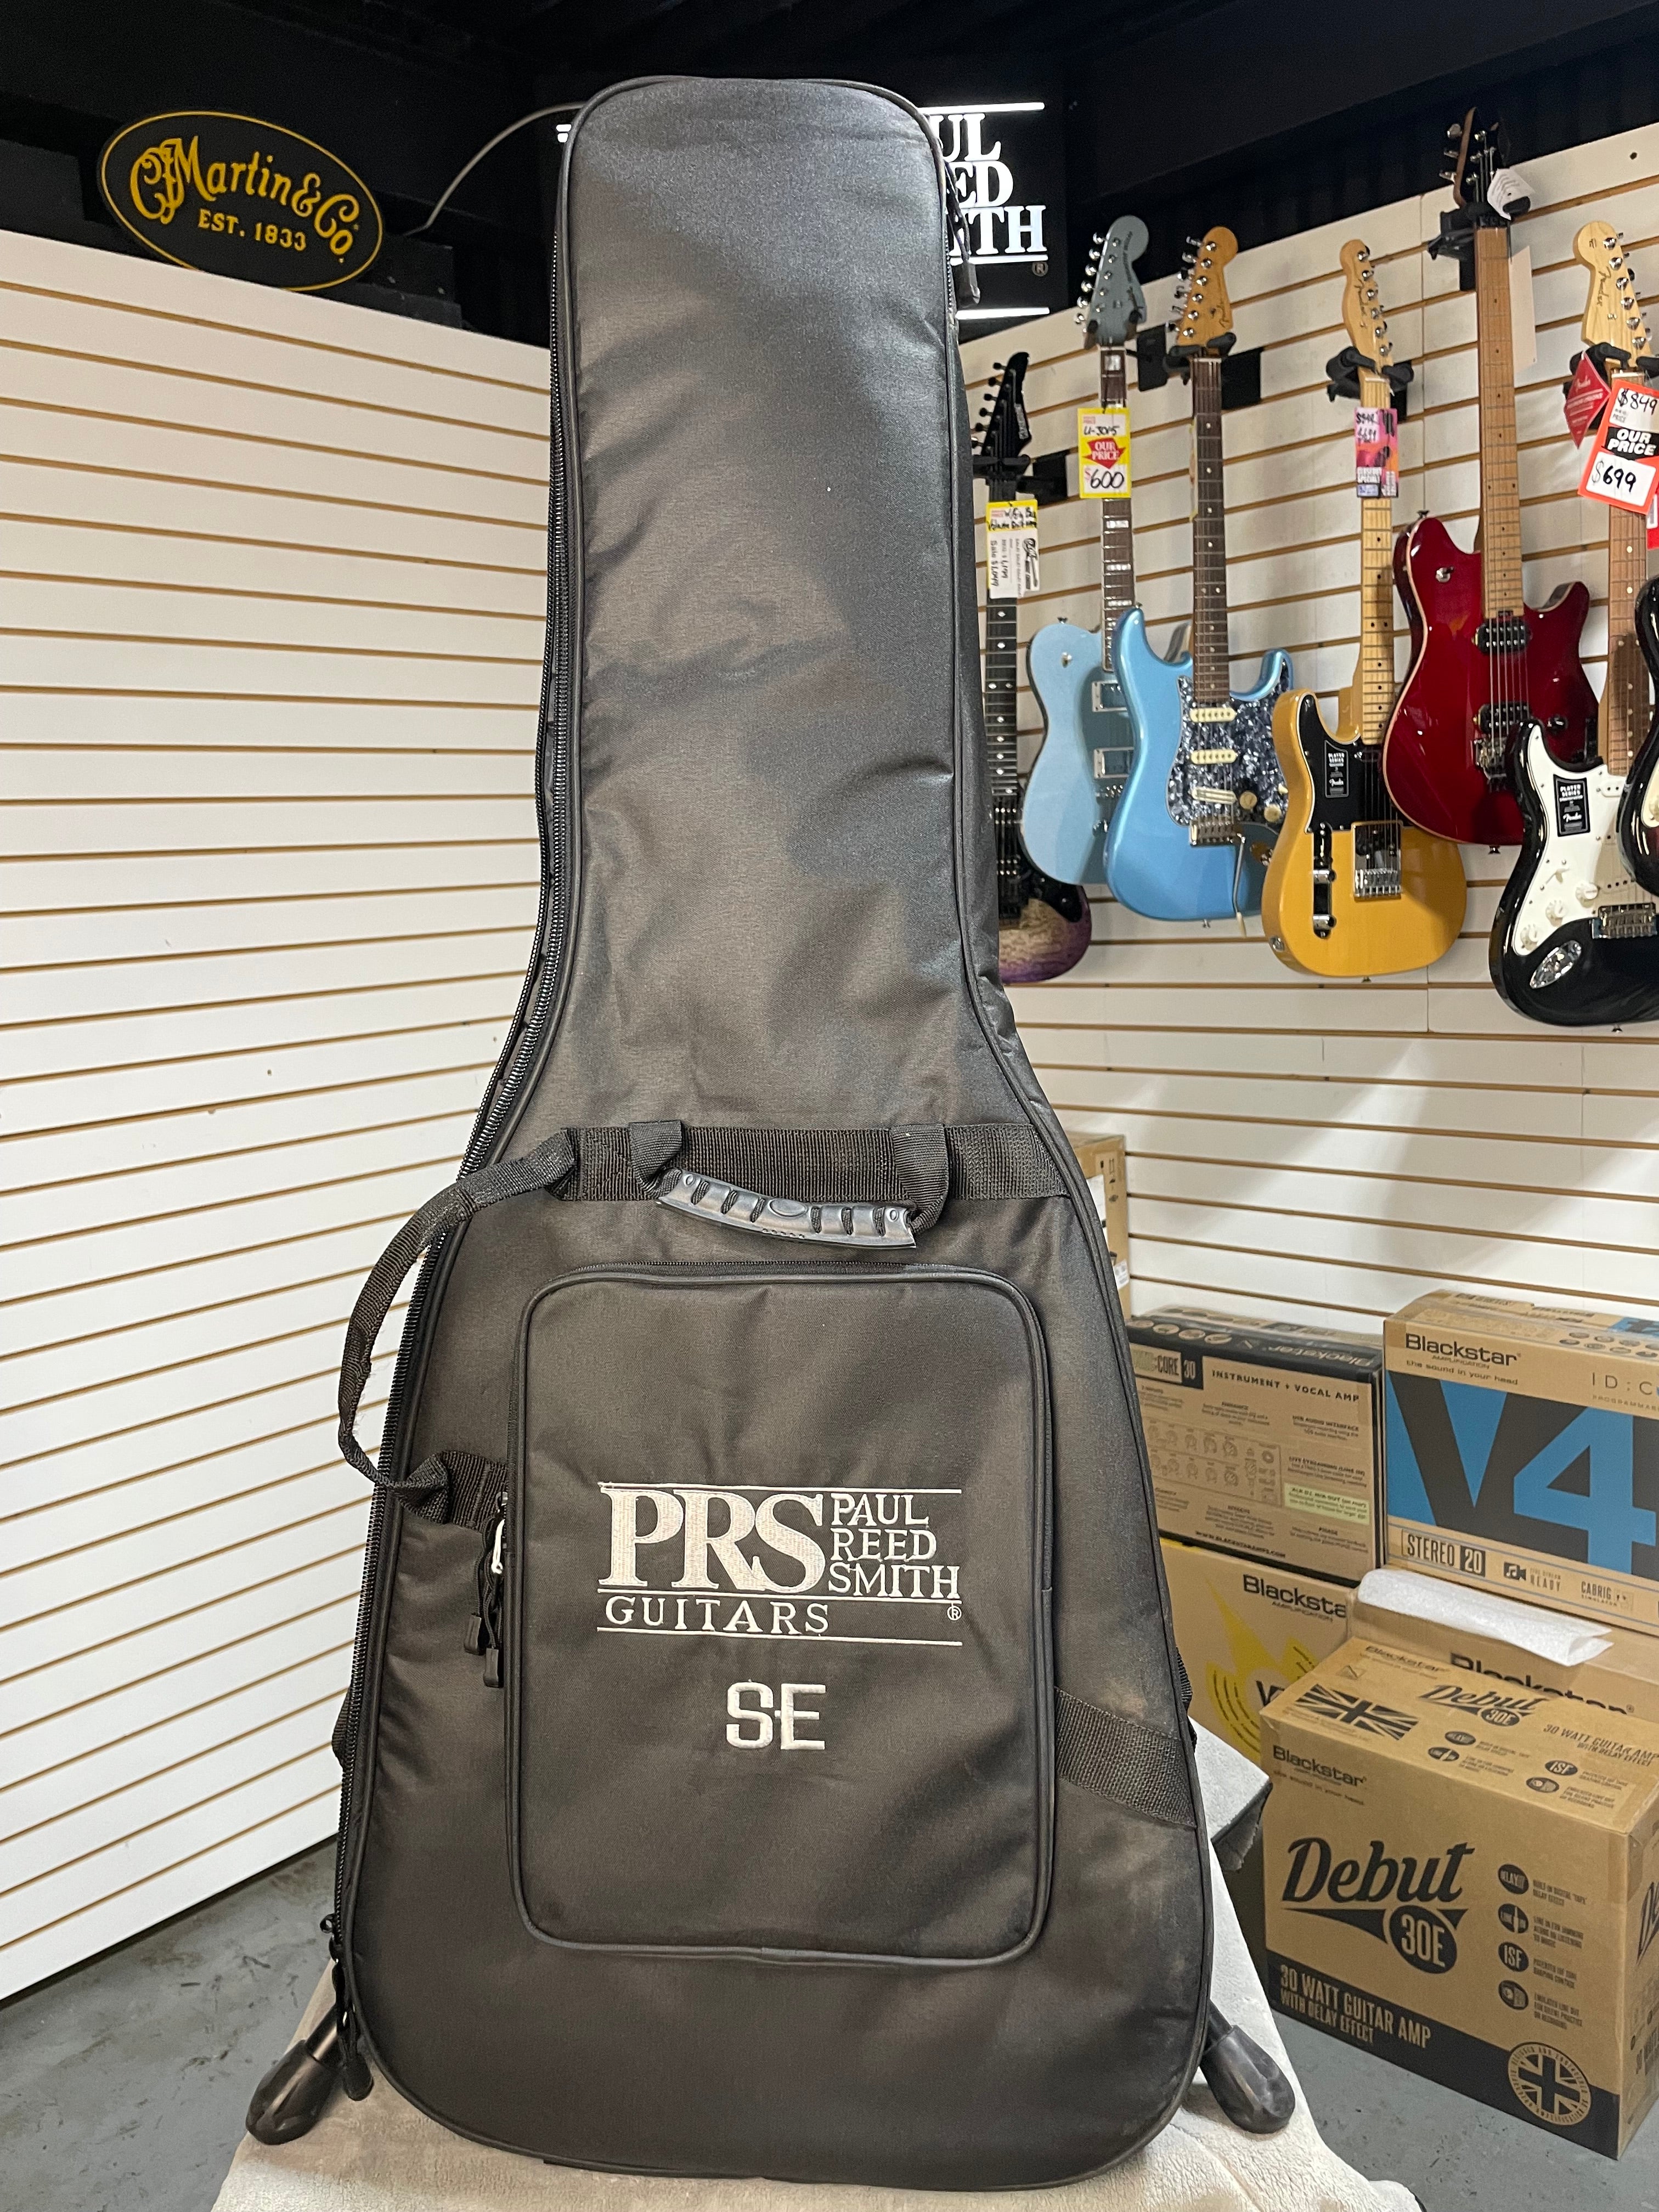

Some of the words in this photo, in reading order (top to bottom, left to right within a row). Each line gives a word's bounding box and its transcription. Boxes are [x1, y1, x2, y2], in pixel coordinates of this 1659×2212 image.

[930, 113, 1001, 162] UL
[949, 160, 1013, 208] ED
[198, 208, 245, 237] EST.
[254, 222, 307, 252] 1833
[1617, 388, 1658, 415] $849
[1094, 441, 1116, 452] OUR
[1607, 438, 1656, 456] PRICE
[1616, 428, 1651, 444] OUR
[1092, 451, 1118, 460] PRICE
[1592, 460, 1637, 493] $699
[1405, 1333, 1517, 1366] Blackstar
[1183, 1359, 1196, 1380] 30
[1211, 1369, 1280, 1389] INSTRUMENT
[1294, 1384, 1331, 1398] VOCAL
[1335, 1391, 1360, 1402] AMP
[1406, 1359, 1423, 1368] the
[1425, 1364, 1454, 1374] sound
[1469, 1372, 1492, 1380] your
[1494, 1374, 1519, 1385] head
[831, 1493, 929, 1526] PAUL
[599, 1487, 826, 1593] PRS
[830, 1527, 937, 1561] REED
[1407, 1534, 1455, 1567] STEREO
[1463, 1548, 1482, 1574] 20
[828, 1562, 961, 1599] SMITH
[1243, 1574, 1346, 1618] Blacksta
[1530, 1575, 1561, 1592] READY
[1581, 1581, 1612, 1600] CABRIG
[605, 1595, 829, 1635] GUITARS
[1419, 1684, 1550, 1711] Debut
[726, 1681, 826, 1750] SE
[1485, 1709, 1515, 1726] 30E
[1543, 1723, 1560, 1735] 30
[1561, 1728, 1592, 1742] WATT
[1592, 1737, 1633, 1755] GUITAR
[1273, 1745, 1364, 1786] Blackstar
[1549, 1761, 1574, 1774] ISF
[1282, 1837, 1475, 1903] Debut
[1401, 1914, 1446, 1968] 30E
[1504, 1944, 1523, 1968] ISF
[1280, 1964, 1298, 1992] 30
[1301, 1973, 1339, 2011] WATT
[1344, 1992, 1394, 2035] GUITAR
[1398, 2016, 1431, 2049] AMP
[1280, 1987, 1306, 2014] WITH
[1308, 2000, 1338, 2028] DELAY
